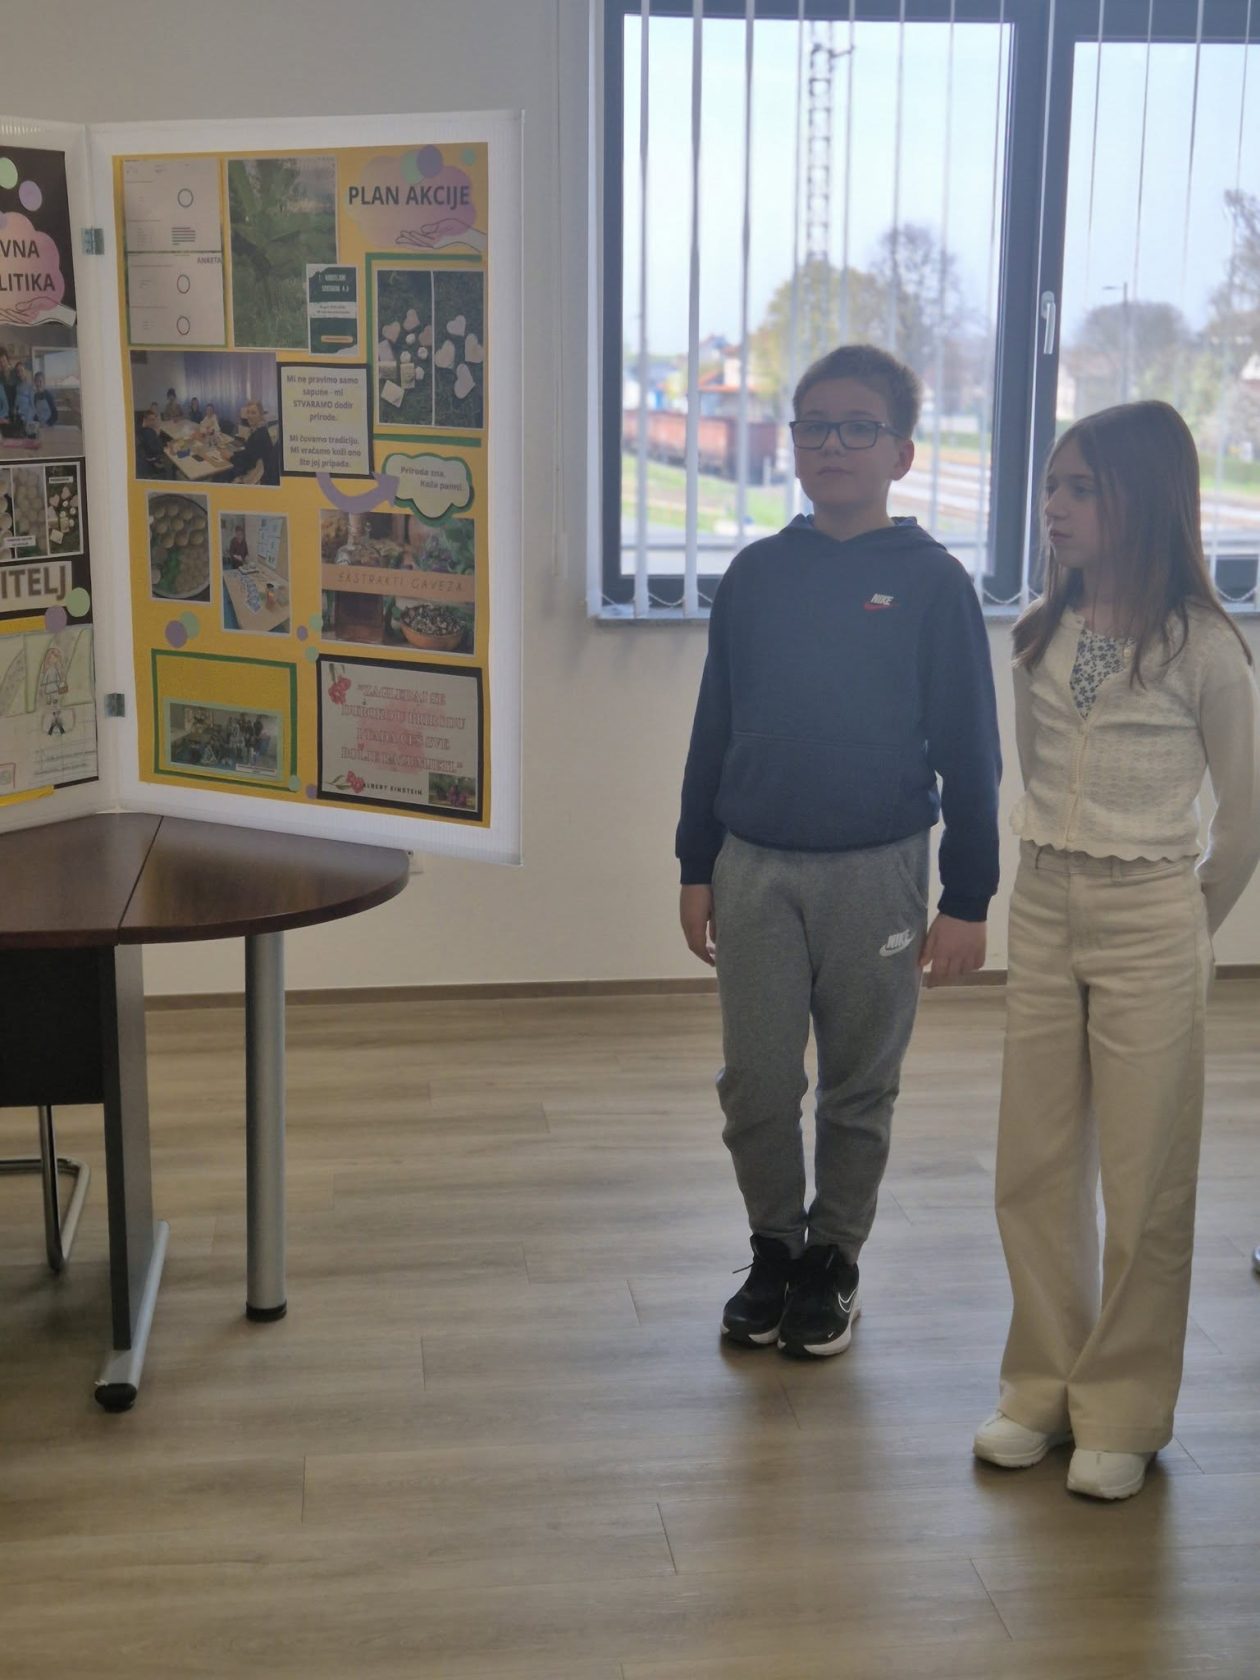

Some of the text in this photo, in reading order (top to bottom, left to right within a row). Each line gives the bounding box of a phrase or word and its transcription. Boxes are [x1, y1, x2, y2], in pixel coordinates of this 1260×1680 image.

[348, 185, 470, 210] PLAN AKCIJE
[0, 239, 40, 258] VNA
[0, 273, 56, 291] LITIKA
[286, 375, 297, 384] Mi
[297, 376, 307, 384] ne
[308, 375, 338, 385] pravimo
[302, 388, 328, 397] sapune
[334, 388, 344, 396] mi
[292, 400, 333, 408] STVARAMO
[1, 565, 66, 601] ITELJ
[337, 572, 464, 592] EKSTRAKTI GAVEZA
[870, 593, 895, 606] NIKE
[390, 785, 423, 796] EINSTEIN
[887, 929, 911, 949] NIKE
